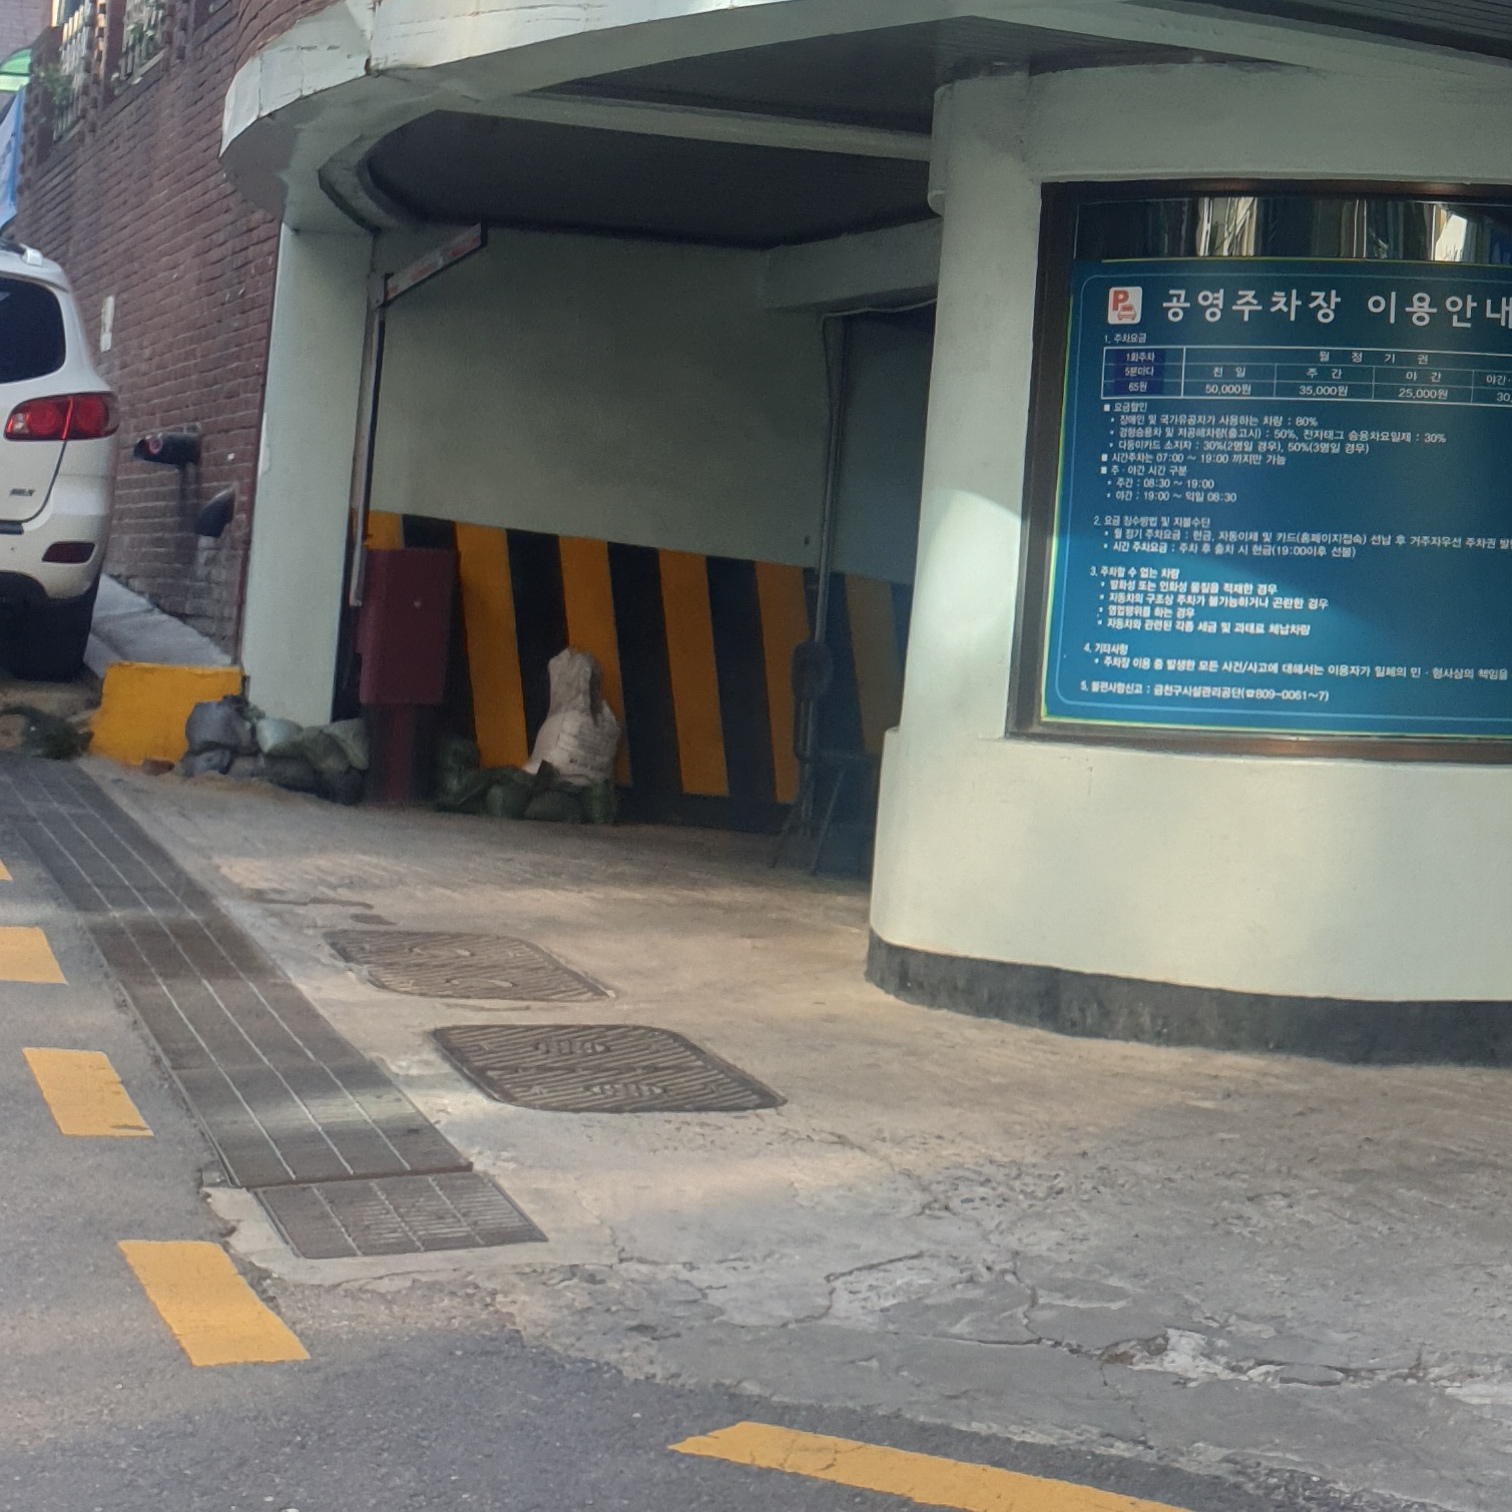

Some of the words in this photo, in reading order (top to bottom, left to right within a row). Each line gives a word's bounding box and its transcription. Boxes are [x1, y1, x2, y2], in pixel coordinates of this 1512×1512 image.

[1162, 289, 1341, 324] 공영주차장
[1114, 332, 1148, 344] 주차요금
[1126, 351, 1156, 363] 1회주차
[1125, 366, 1155, 378] 5분마다
[1128, 380, 1148, 393] 65원
[1205, 383, 1252, 396] 50,000원
[1299, 385, 1349, 398] 35,000원
[1398, 387, 1449, 401] 25,000원
[1113, 401, 1148, 413] 요금할인
[1119, 414, 1146, 426] 장애인
[1148, 414, 1157, 425] 및
[1160, 414, 1216, 427] 국가유공자가
[1219, 415, 1259, 427] 사용하는
[1262, 416, 1283, 428] 차량
[1295, 416, 1319, 428] 80%
[1165, 427, 1174, 438] 및
[1177, 427, 1262, 441] 저공해차량(출고시)
[1302, 429, 1345, 441] 전자태그
[1347, 430, 1412, 443] 승용차요일제
[1423, 432, 1447, 444] 30%
[1118, 440, 1161, 451] 다둥이카드
[1163, 440, 1192, 452] 소지자
[1344, 443, 1370, 455] 경우)
[1112, 452, 1154, 463] 시간주차는
[1156, 452, 1184, 463] 07:00
[1200, 453, 1229, 464] 19:00
[1232, 453, 1262, 465] 까지만
[1265, 454, 1286, 466] 가능
[1110, 465, 1120, 475] 주
[1127, 465, 1145, 476] 야간
[1148, 465, 1166, 476] 시간
[1169, 465, 1187, 477] 구분
[1116, 478, 1134, 489] 주간
[1143, 478, 1170, 489] 08:30
[1186, 479, 1215, 490] 19:00
[1115, 490, 1133, 501] 야간
[1143, 491, 1170, 501] 19:00
[1186, 491, 1205, 503] 익일
[1207, 492, 1238, 503] 08:30
[1104, 515, 1121, 526] 요금
[1123, 516, 1158, 528] 징수방법
[1160, 516, 1170, 528] 및
[1173, 517, 1211, 529] 지불수단
[1113, 529, 1123, 540] 월
[1125, 529, 1143, 541] 정기
[1145, 530, 1181, 542] 주차요금
[1218, 531, 1260, 543] 자동이체
[1262, 532, 1273, 544] 및
[1275, 532, 1367, 546] 카드(홈페이지접속)
[1370, 534, 1392, 546] 선납
[1394, 535, 1406, 546] 후
[1410, 535, 1462, 548] 거주자우선
[1464, 537, 1497, 549] 주차권
[1112, 541, 1130, 552] 시간
[1132, 542, 1168, 554] 주차요금
[1179, 543, 1198, 555] 주차
[1201, 544, 1211, 554] 후
[1214, 544, 1235, 556] 출차
[1238, 545, 1248, 556] 시
[1100, 565, 1125, 578] 주차할
[1127, 566, 1137, 577] 수
[1139, 567, 1158, 579] 없는
[1161, 568, 1180, 580] 차량
[1109, 579, 1136, 591] 발화성
[1138, 580, 1157, 592] 또는
[1159, 581, 1188, 593] 인화성
[1190, 582, 1220, 594] 물질을
[1222, 583, 1254, 595] 적재한
[1257, 584, 1278, 596] 경우
[1108, 592, 1143, 604] 자동차의
[1145, 593, 1174, 605] 구조상
[1177, 594, 1206, 606] 주차가
[1208, 595, 1269, 608] 불가능하거나
[1271, 596, 1305, 610] 곤란한
[1307, 598, 1329, 611] 경우
[1108, 605, 1151, 618] 영업행위를
[1153, 606, 1173, 619] 하는
[1175, 607, 1195, 619] 경우
[1106, 618, 1142, 631] 자동차와
[1144, 619, 1172, 632] 관련된
[1175, 620, 1194, 632] 각종
[1197, 621, 1217, 633] 세금
[1220, 622, 1231, 634] 및
[1234, 622, 1266, 635] 과태료
[1268, 623, 1311, 636] 체납차량
[1094, 642, 1129, 655] 기타사항
[1103, 656, 1130, 669] 주차장
[1132, 657, 1151, 669] 이용
[1153, 658, 1164, 670] 중
[1166, 658, 1197, 671] 발생한
[1198, 660, 1219, 672] 모든
[1221, 660, 1279, 674] 사건/사고에
[1282, 662, 1324, 676] 대해서는
[1327, 664, 1371, 676] 이용자가
[1374, 666, 1407, 678] 일체의
[1410, 667, 1422, 678] 민
[1432, 667, 1474, 680] 형사상의
[1477, 668, 1508, 681] 책임을
[1091, 680, 1143, 694] 불편사항신고
